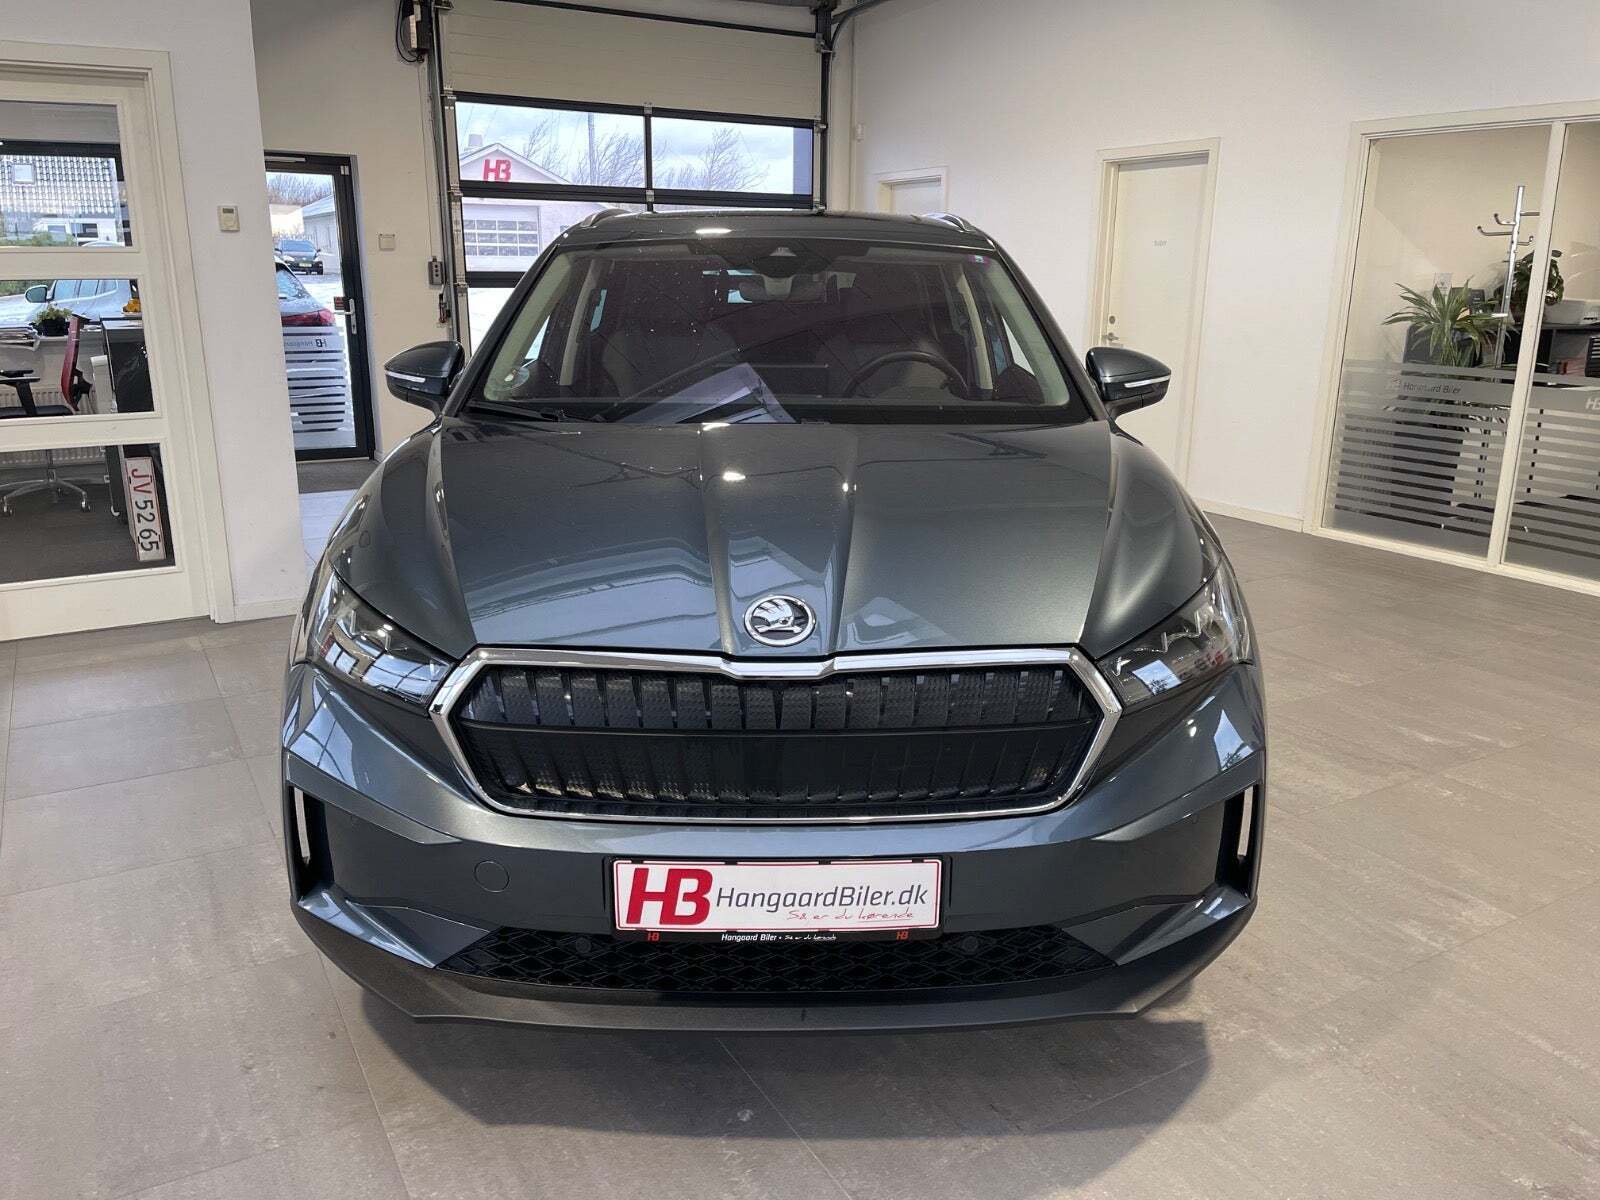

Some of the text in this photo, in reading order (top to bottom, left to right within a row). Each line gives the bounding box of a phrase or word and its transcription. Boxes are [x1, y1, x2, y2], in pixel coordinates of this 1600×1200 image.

[483, 159, 511, 183] HB
[131, 468, 160, 552] JV 52 65
[626, 867, 928, 926] HB HangaardBiler.dk
[721, 933, 758, 942] Hangaard
[760, 933, 777, 941] Biler
